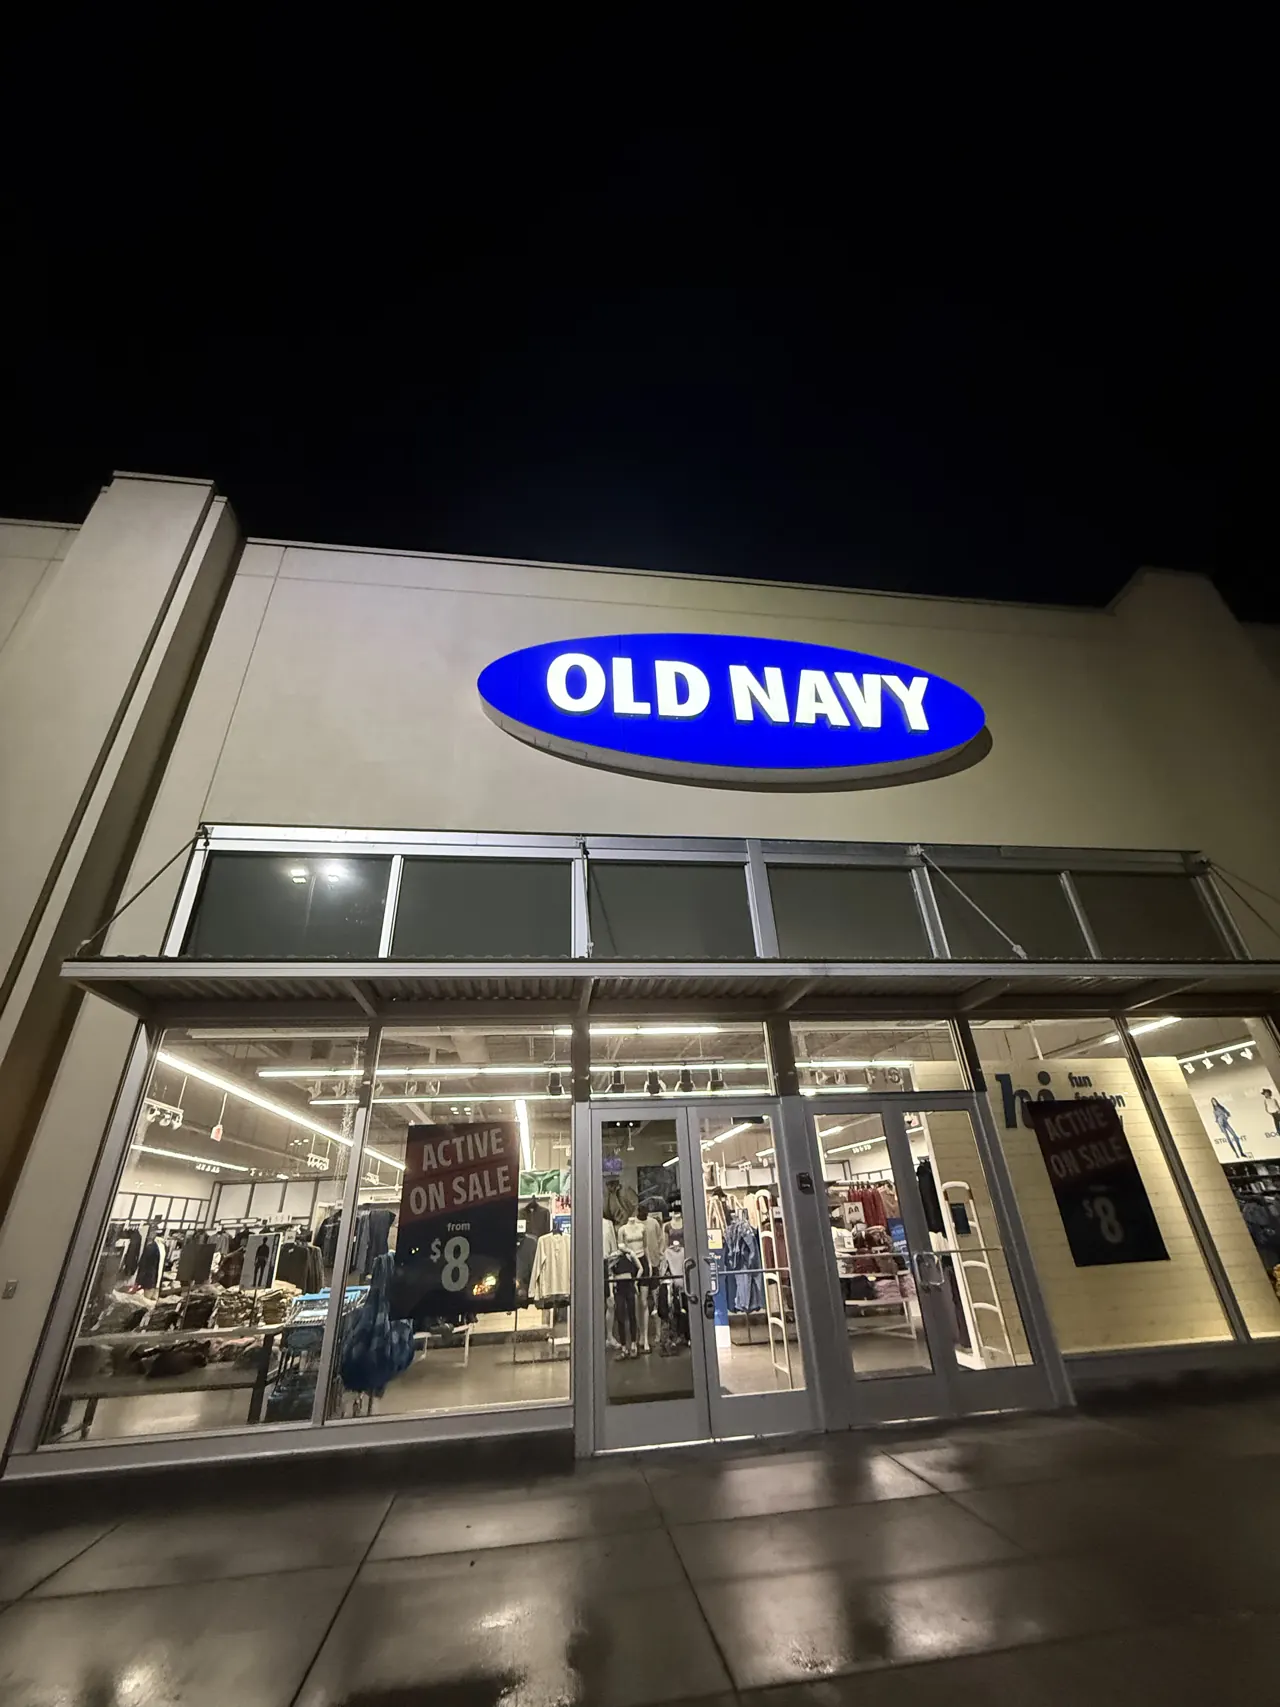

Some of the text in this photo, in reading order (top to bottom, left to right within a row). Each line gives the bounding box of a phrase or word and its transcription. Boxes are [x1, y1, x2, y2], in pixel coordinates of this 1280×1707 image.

[546, 652, 930, 732] OLD NAVY
[1068, 1072, 1093, 1088] fun
[1043, 1104, 1109, 1142] ACTIVE
[422, 1128, 505, 1171] ACTIVE
[1050, 1136, 1128, 1179] ON SALE
[410, 1165, 512, 1215] ON SALE
[447, 1222, 471, 1232] from
[430, 1236, 471, 1292] $8
